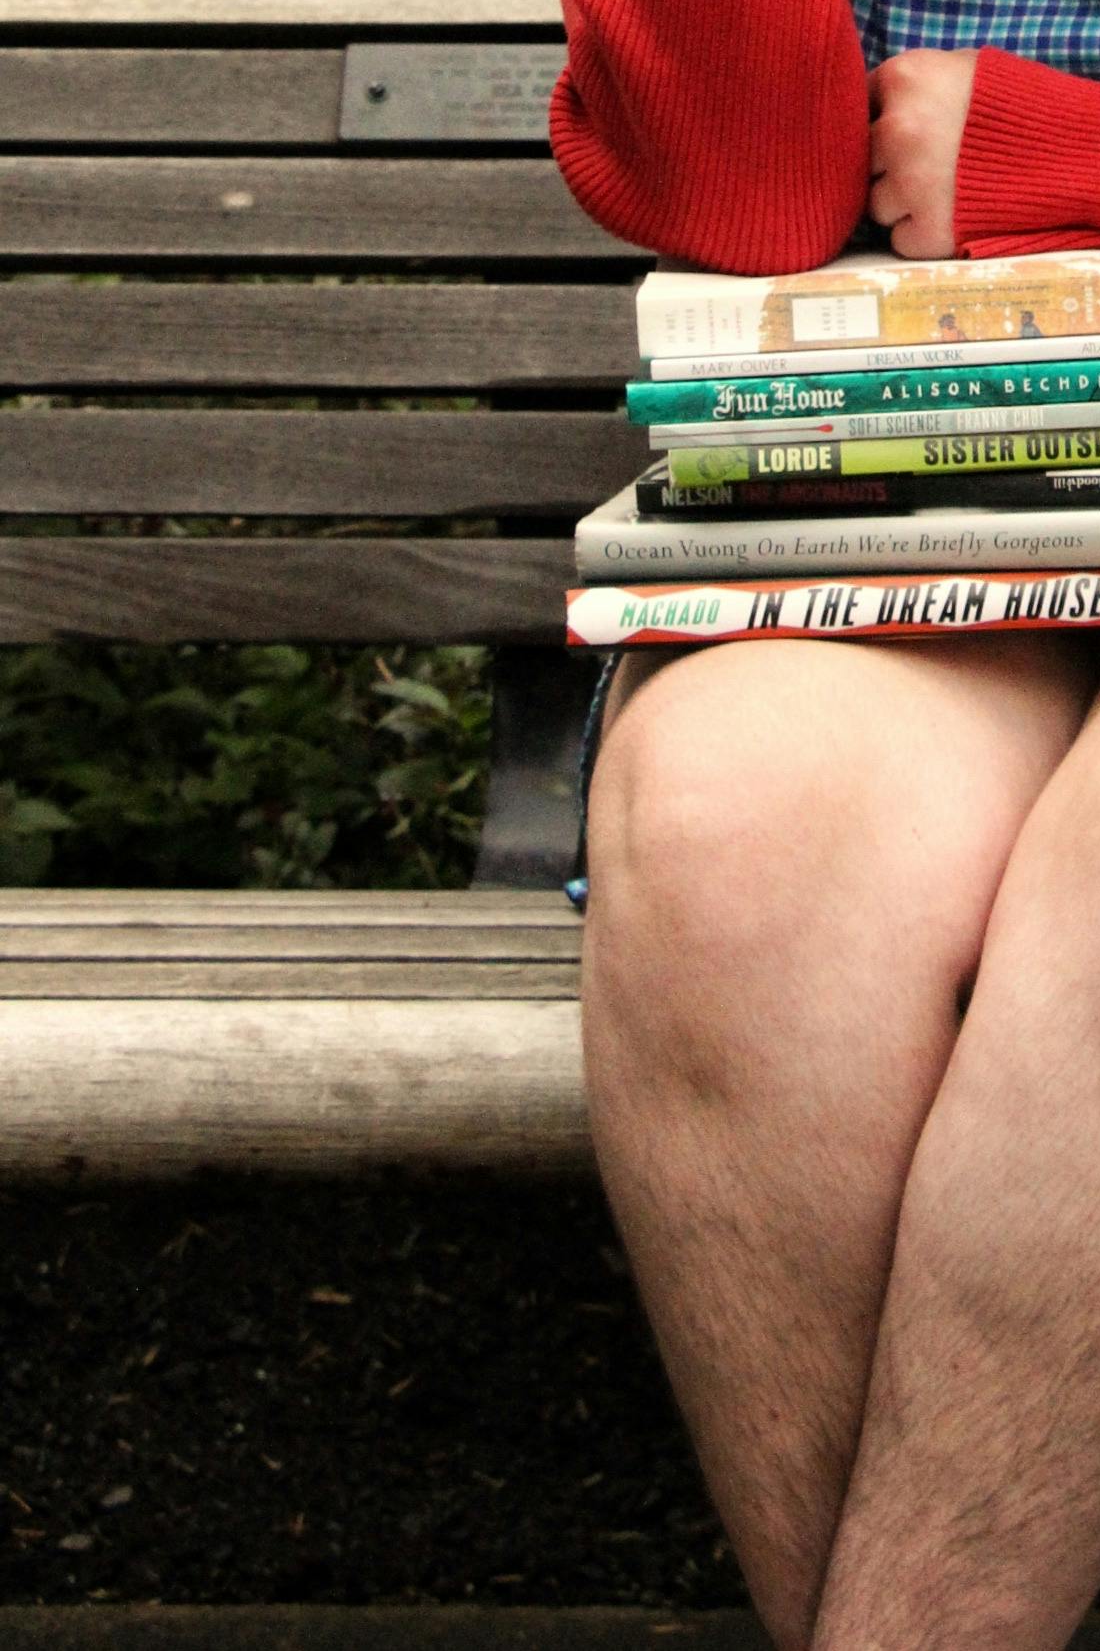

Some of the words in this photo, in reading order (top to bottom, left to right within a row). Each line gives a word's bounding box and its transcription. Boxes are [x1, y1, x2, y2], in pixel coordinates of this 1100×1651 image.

[691, 361, 734, 375] MARY
[740, 358, 788, 373] OLIVER
[866, 351, 915, 366] DREAM
[923, 348, 964, 363] WORK
[713, 383, 768, 419] Fun
[769, 381, 846, 416] Home
[882, 380, 981, 400] ALISON
[848, 415, 885, 437] SOFT
[886, 413, 942, 435] SCIENCE
[956, 409, 1008, 431] FRANNY
[757, 445, 833, 474] LORDE
[923, 434, 1015, 466] SISTER
[660, 485, 733, 507] NELSON
[604, 540, 673, 561] Ocean
[679, 539, 748, 563] Vuong
[757, 538, 785, 555] On
[794, 535, 850, 556] Earth
[858, 533, 909, 554] We're
[919, 531, 985, 557] Briefly
[993, 531, 1084, 556] Gorgeous
[620, 598, 721, 628] MACHADO
[747, 591, 786, 629] IN
[803, 586, 863, 629] THE
[876, 582, 990, 625] DREAM
